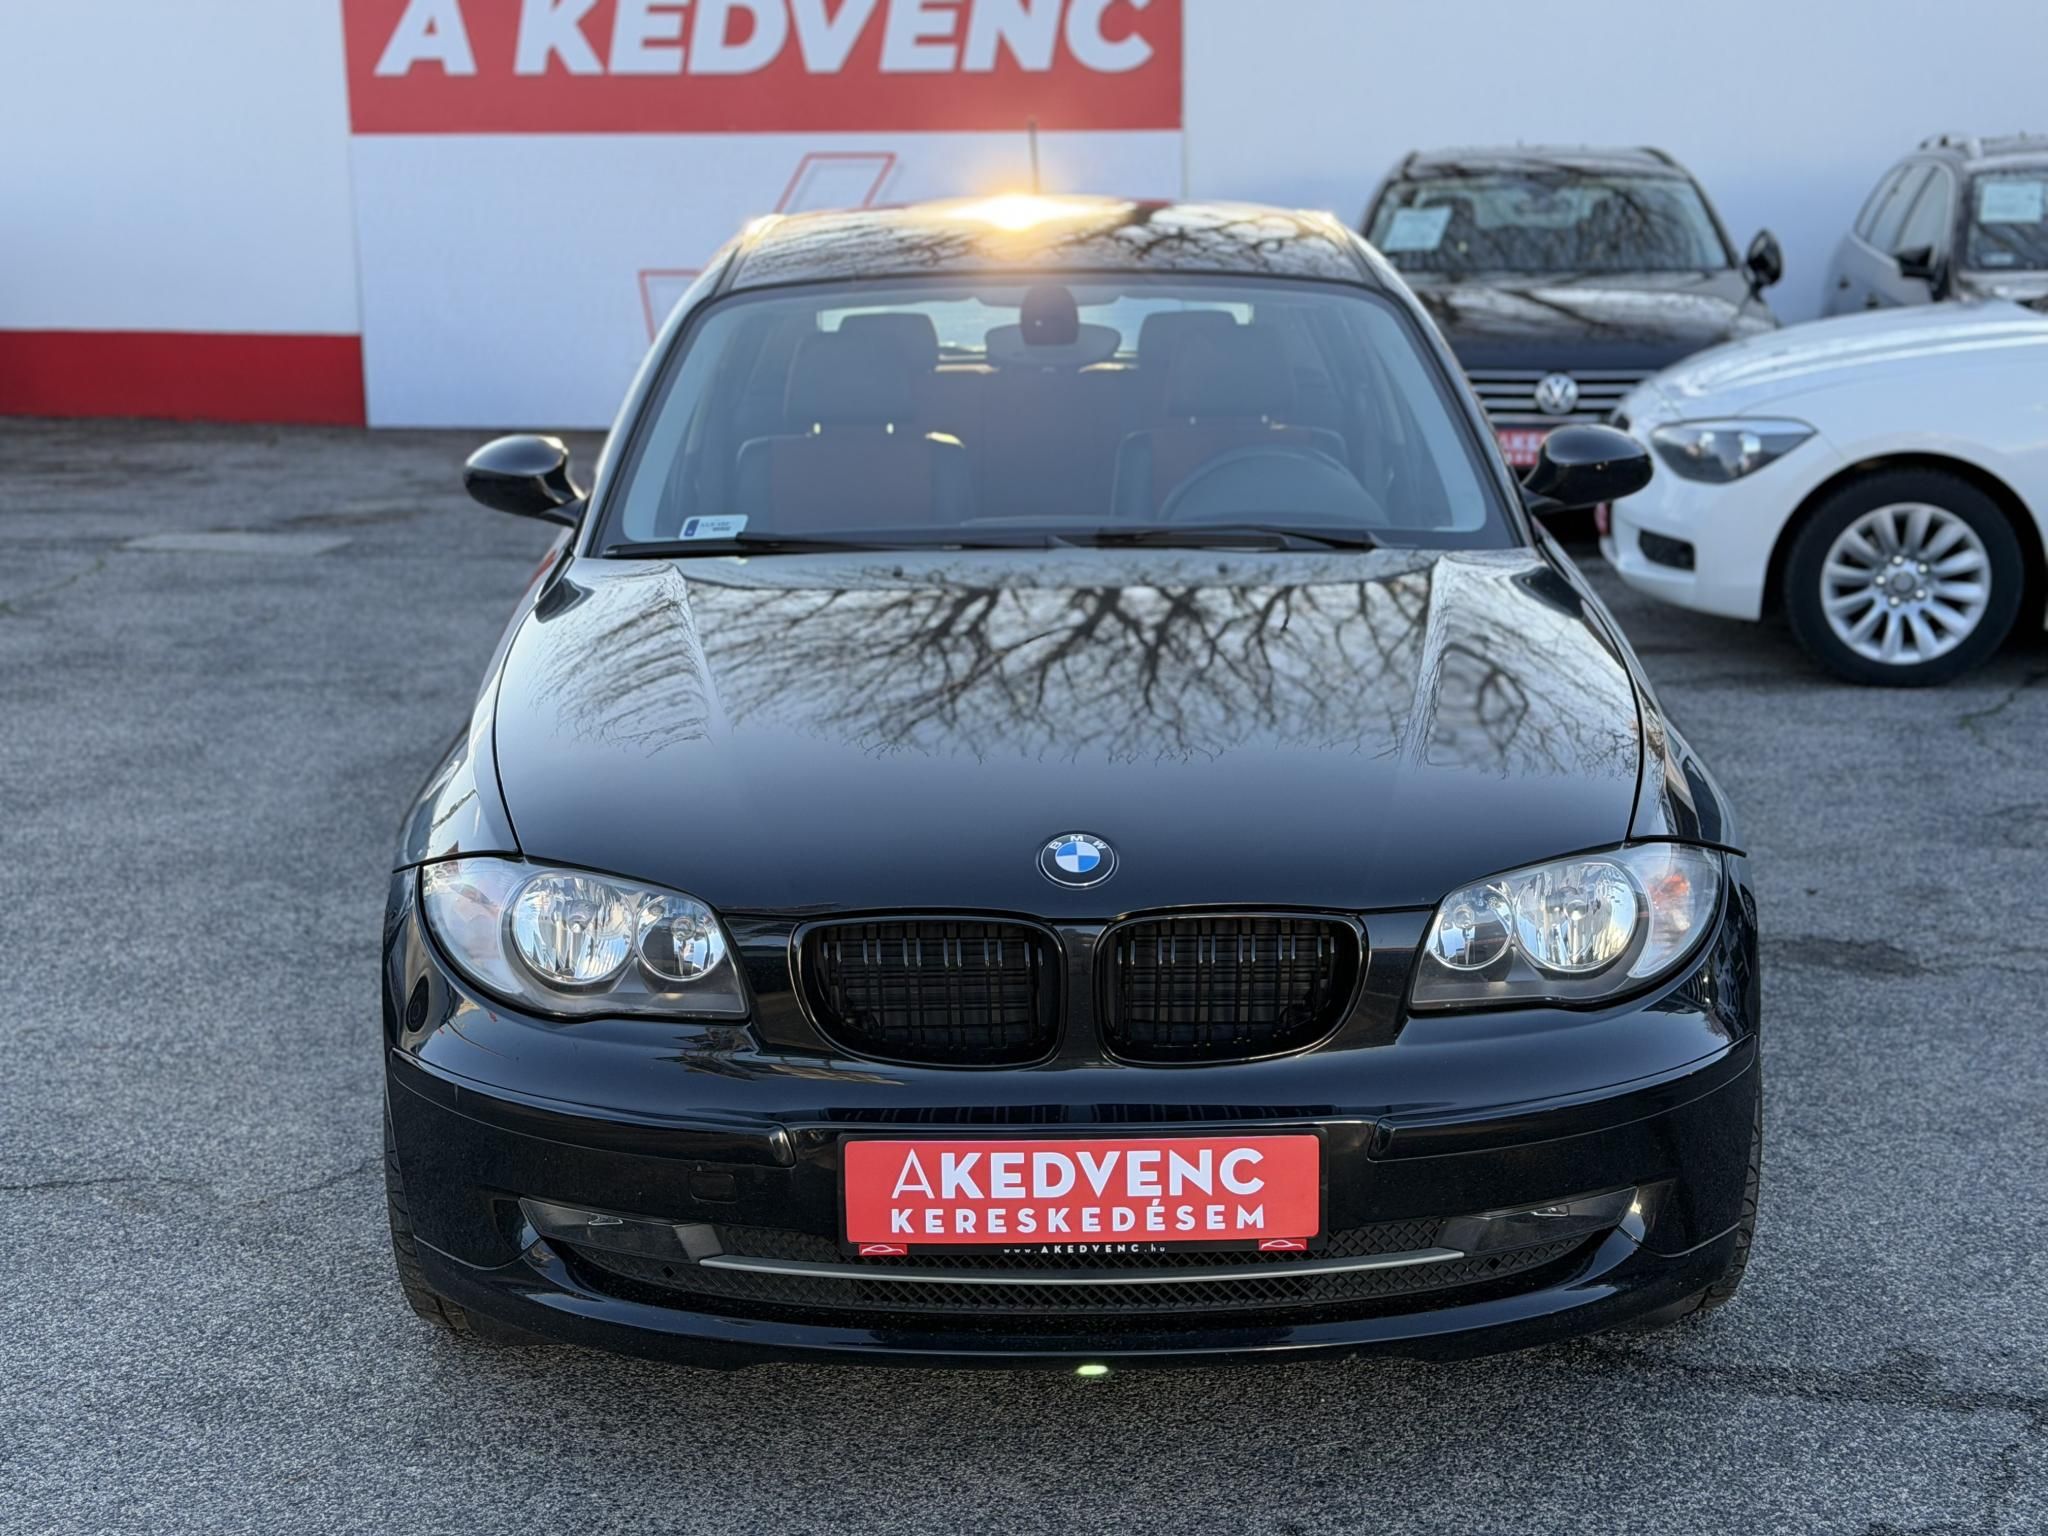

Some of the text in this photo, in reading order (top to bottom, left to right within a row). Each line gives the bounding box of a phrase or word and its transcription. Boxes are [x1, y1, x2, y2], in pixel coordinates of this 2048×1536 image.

[373, 0, 1154, 75] A KEDVENC
[1048, 835, 1106, 850] BMW
[891, 1199, 1265, 1233] KERESKEDÉSEM
[1004, 1244, 1166, 1254] www.AKEDVENC.hu
